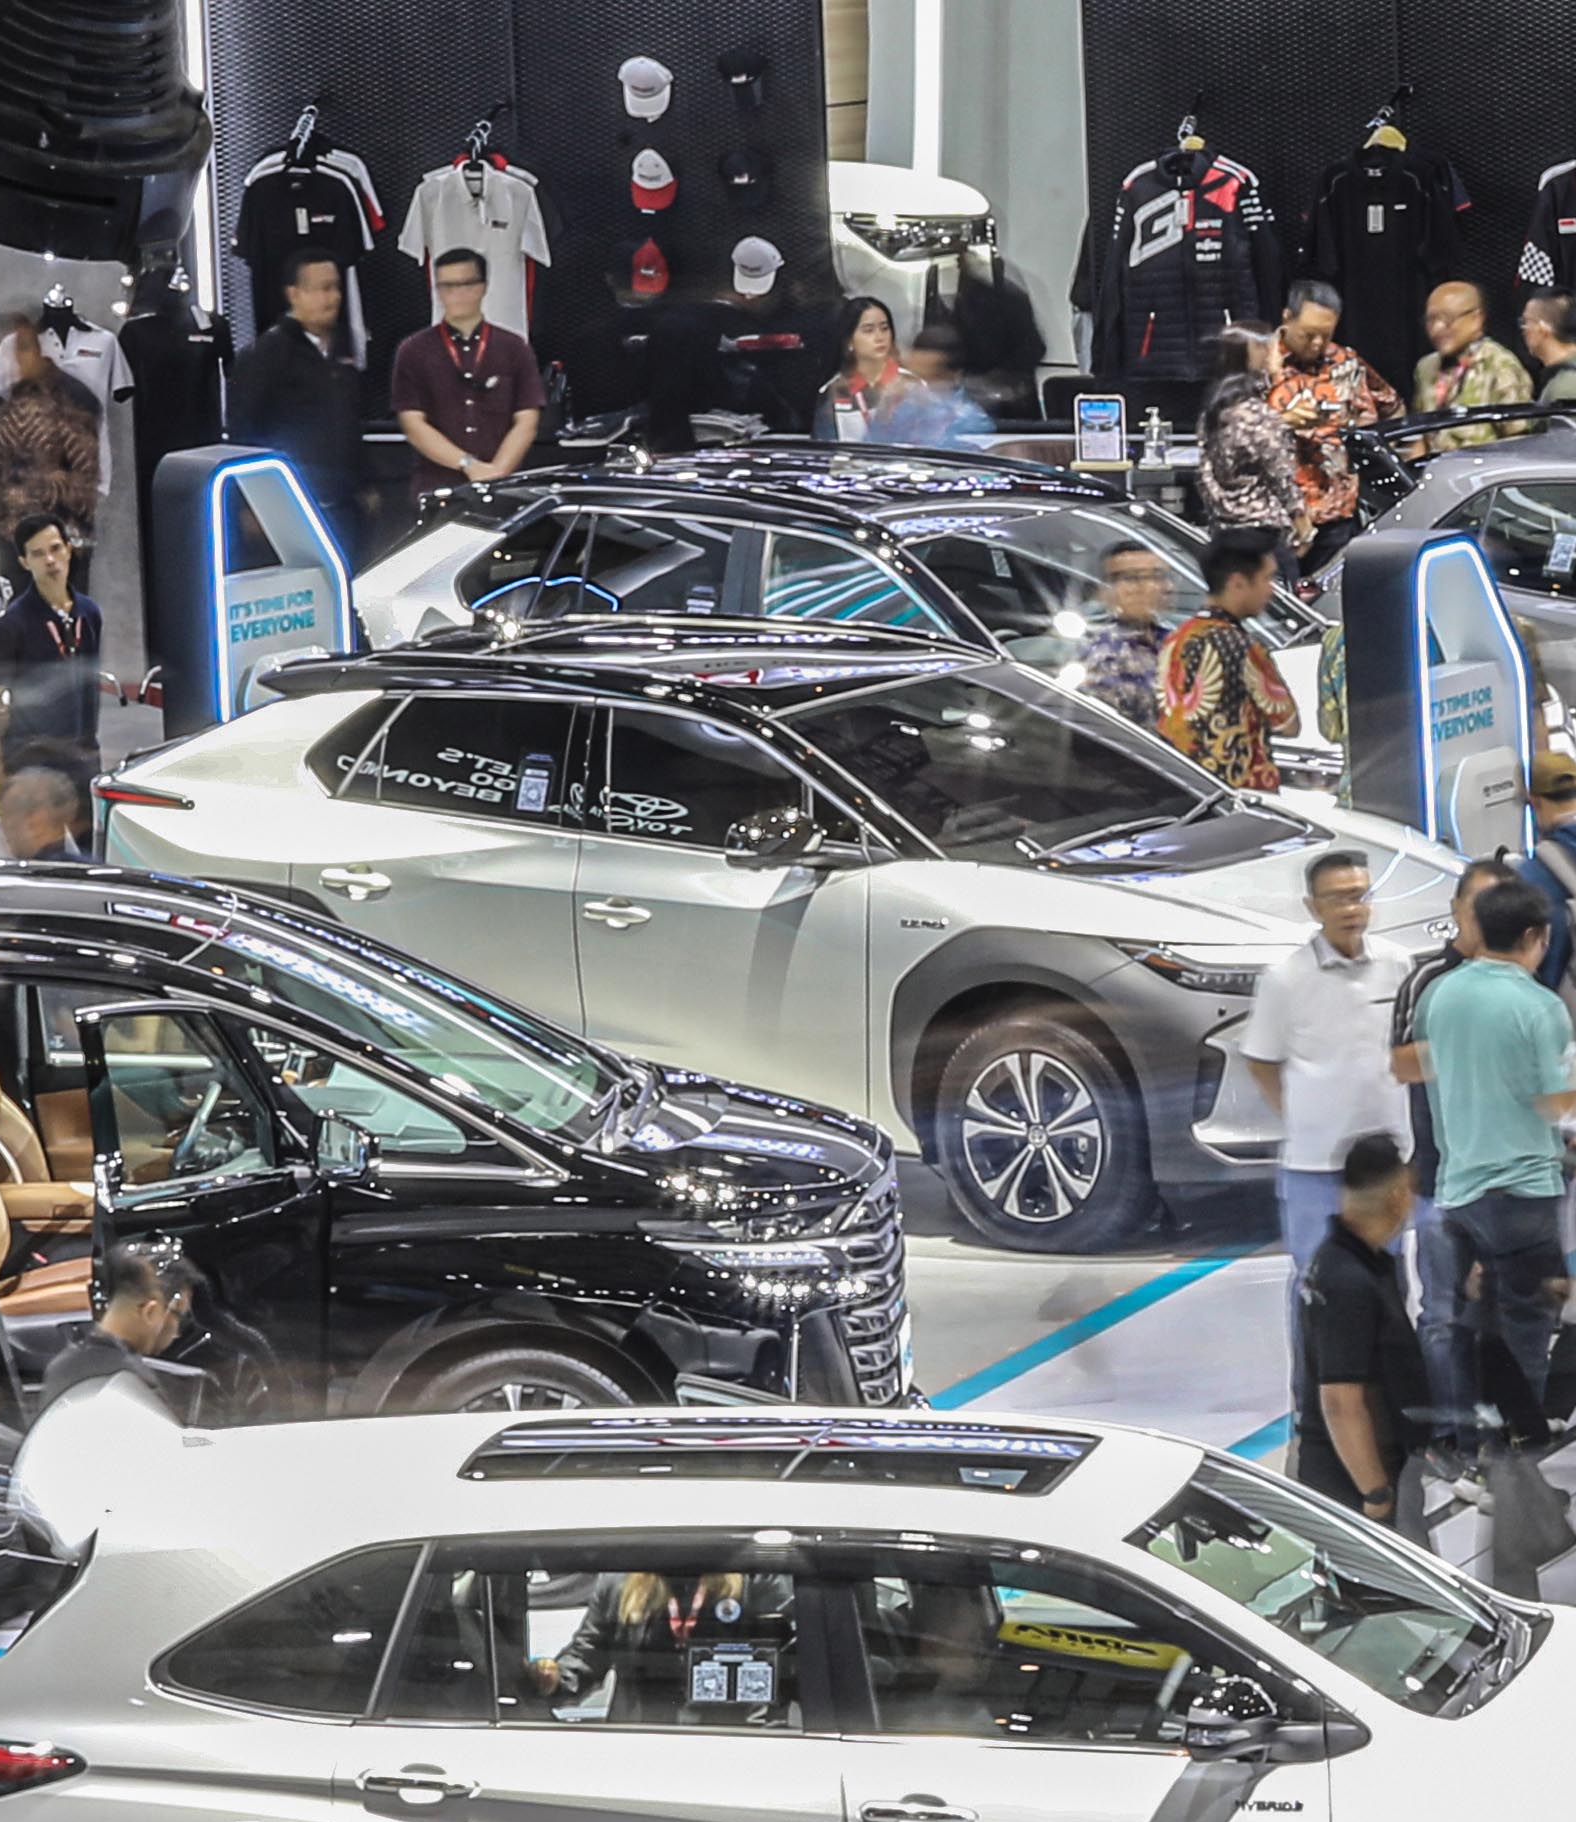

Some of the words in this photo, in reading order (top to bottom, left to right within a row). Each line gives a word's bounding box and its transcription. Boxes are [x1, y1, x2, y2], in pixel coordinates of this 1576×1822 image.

[287, 589, 313, 608] FOR
[231, 608, 314, 643] EVERYONE
[1472, 686, 1492, 703] FOR
[1432, 707, 1494, 742] VERYONE
